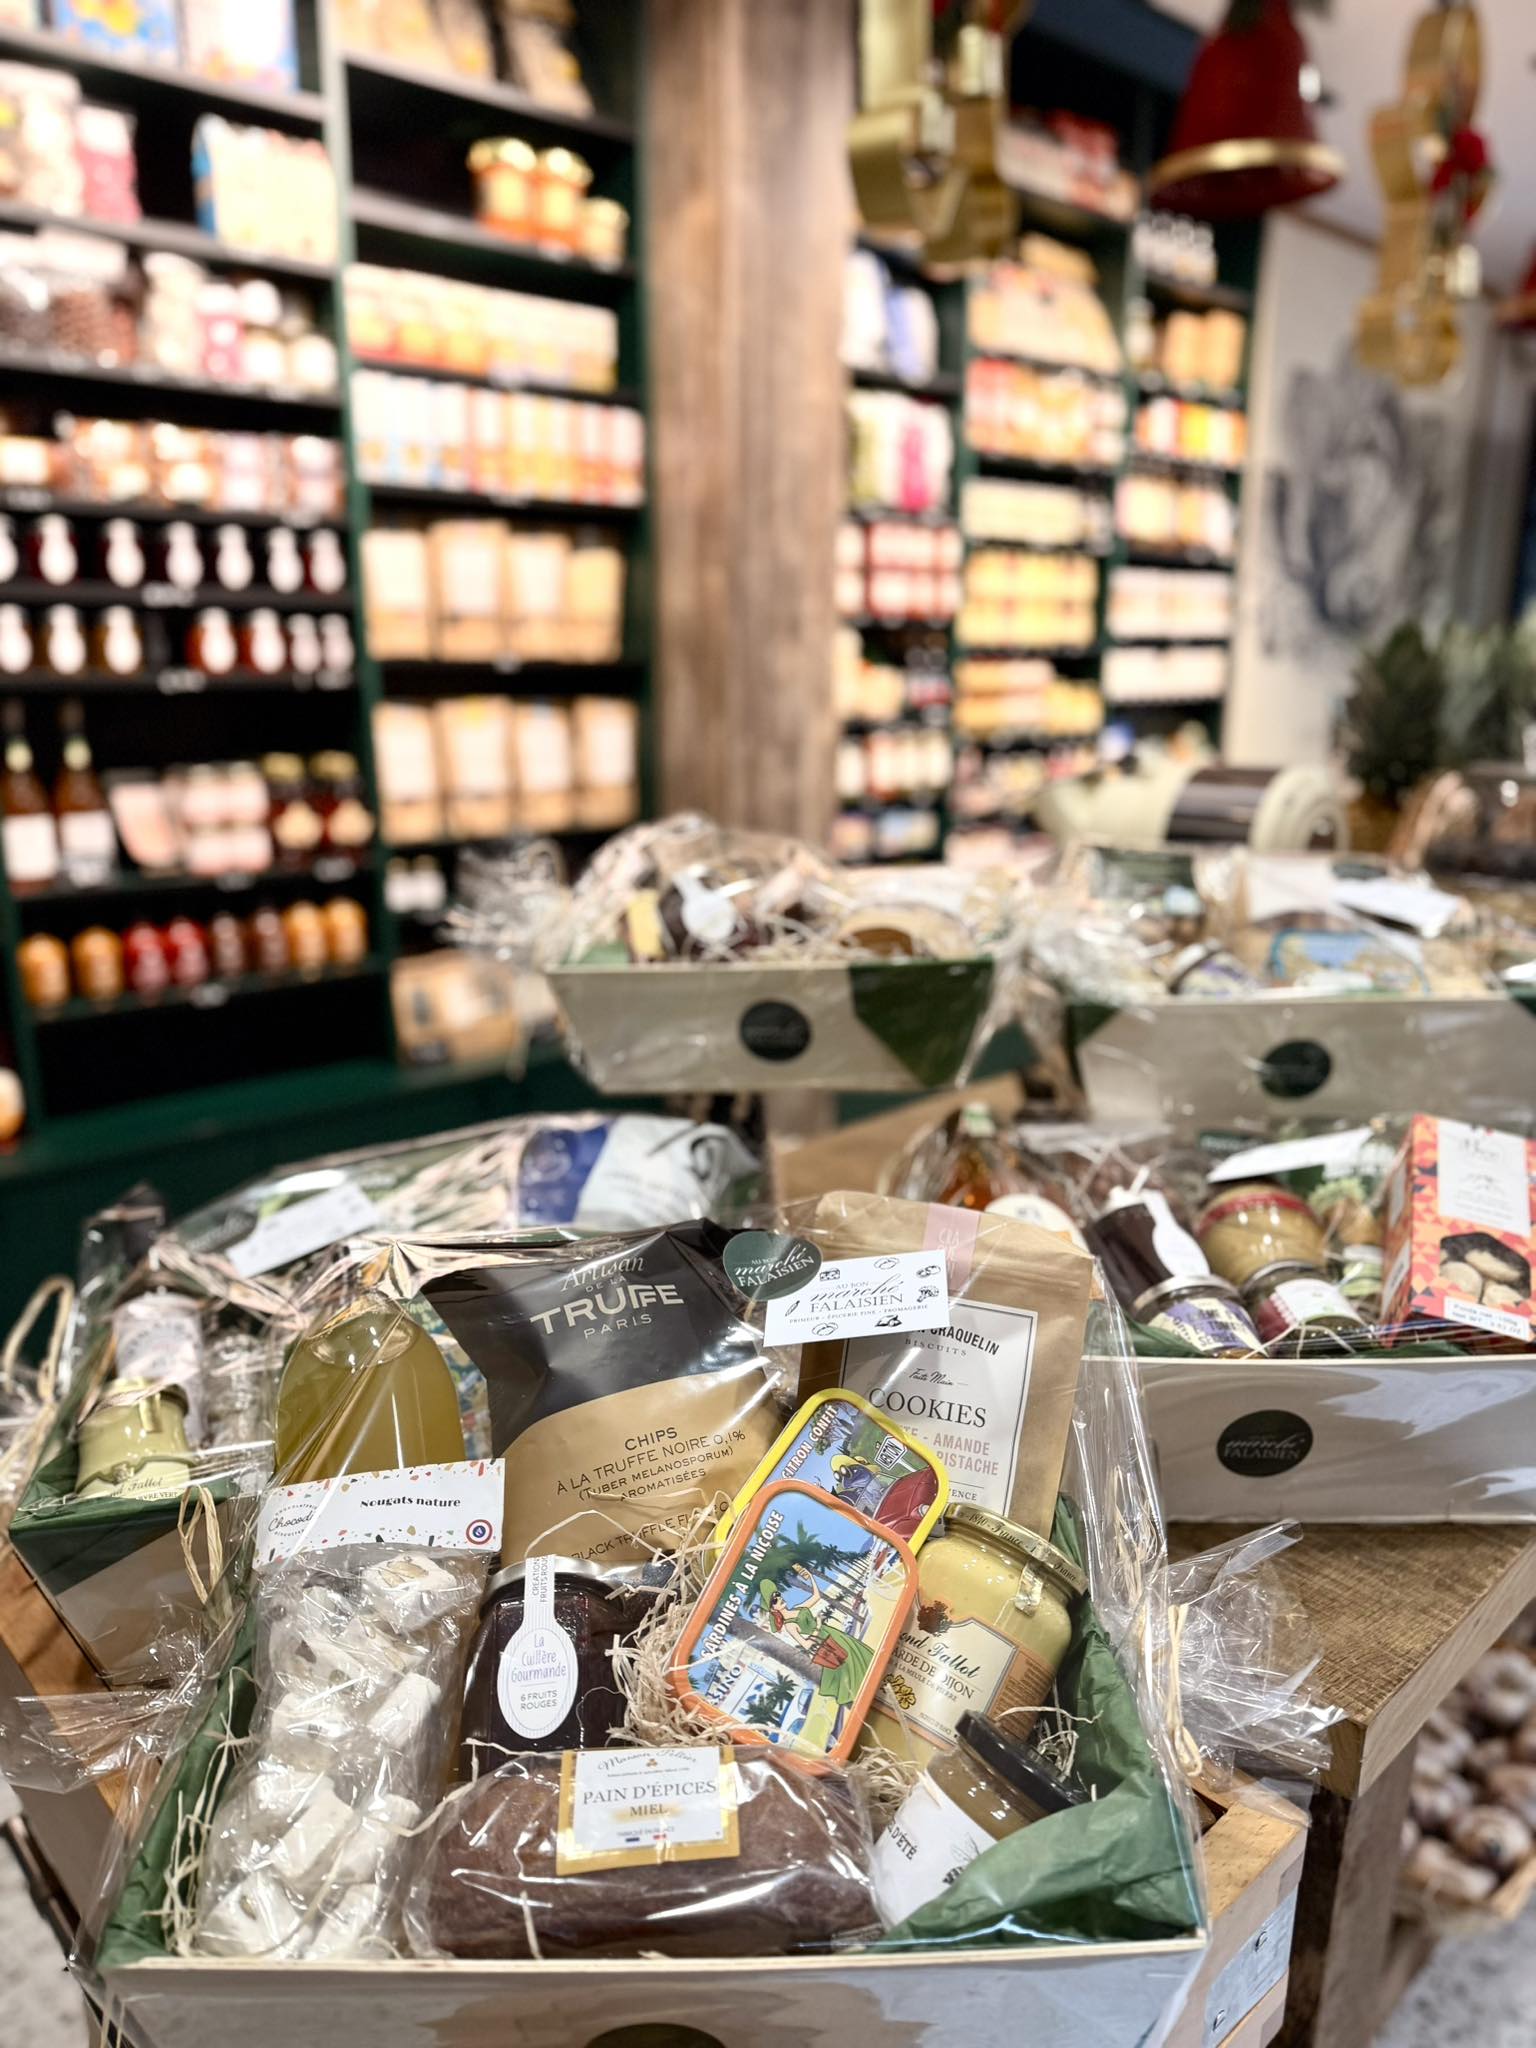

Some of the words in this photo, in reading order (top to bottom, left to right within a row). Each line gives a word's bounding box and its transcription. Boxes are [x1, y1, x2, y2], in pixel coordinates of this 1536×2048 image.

[735, 1243, 807, 1275] marché
[738, 1256, 815, 1287] FALAISIEN
[560, 1256, 645, 1292] Artisan
[610, 1276, 627, 1286] LA
[810, 1273, 904, 1302] marché
[529, 1284, 685, 1335] TRUFFE
[810, 1294, 903, 1313] FALAISIEN
[583, 1313, 653, 1340] PARIS
[789, 1315, 820, 1324] PRIMEUR
[905, 1338, 968, 1357] BISCUITS
[869, 1387, 987, 1429] COOKIES
[624, 1427, 678, 1451] CHIPS
[781, 1442, 812, 1479] CITRON
[808, 1405, 839, 1442] CONFIT
[933, 1432, 991, 1457] AMANDE
[570, 1473, 591, 1490] LA
[593, 1449, 659, 1480] TRUFFE
[662, 1435, 711, 1459] NOIRE
[632, 1445, 734, 1483] MELANOSPORUM)
[936, 1451, 999, 1477] PISTACHE
[359, 1495, 414, 1509] Nougats
[416, 1497, 461, 1507] nature
[949, 1489, 977, 1502] ENCE
[268, 1510, 314, 1532] Chocodi
[540, 1577, 548, 1603] FRUITS
[700, 1592, 743, 1659] SARDINES
[732, 1580, 749, 1594] À
[741, 1562, 759, 1582] LA
[751, 1509, 785, 1566] NIÇOISE
[534, 1633, 545, 1648] La
[522, 1652, 557, 1667] Cuillère
[892, 1647, 919, 1667] ARDE
[919, 1661, 936, 1676] DE
[899, 1631, 927, 1651] ond
[928, 1641, 981, 1680] Fallot
[511, 1663, 567, 1683] Gourmande
[520, 1693, 526, 1702] 6
[527, 1690, 558, 1700] FRUITS
[520, 1700, 558, 1711] ROUGES
[583, 1787, 628, 1805] PAIN
[633, 1780, 717, 1800] D'ÉPICES
[629, 1803, 668, 1817] MIEL
[892, 1826, 918, 1860] D'ÉTÉ
